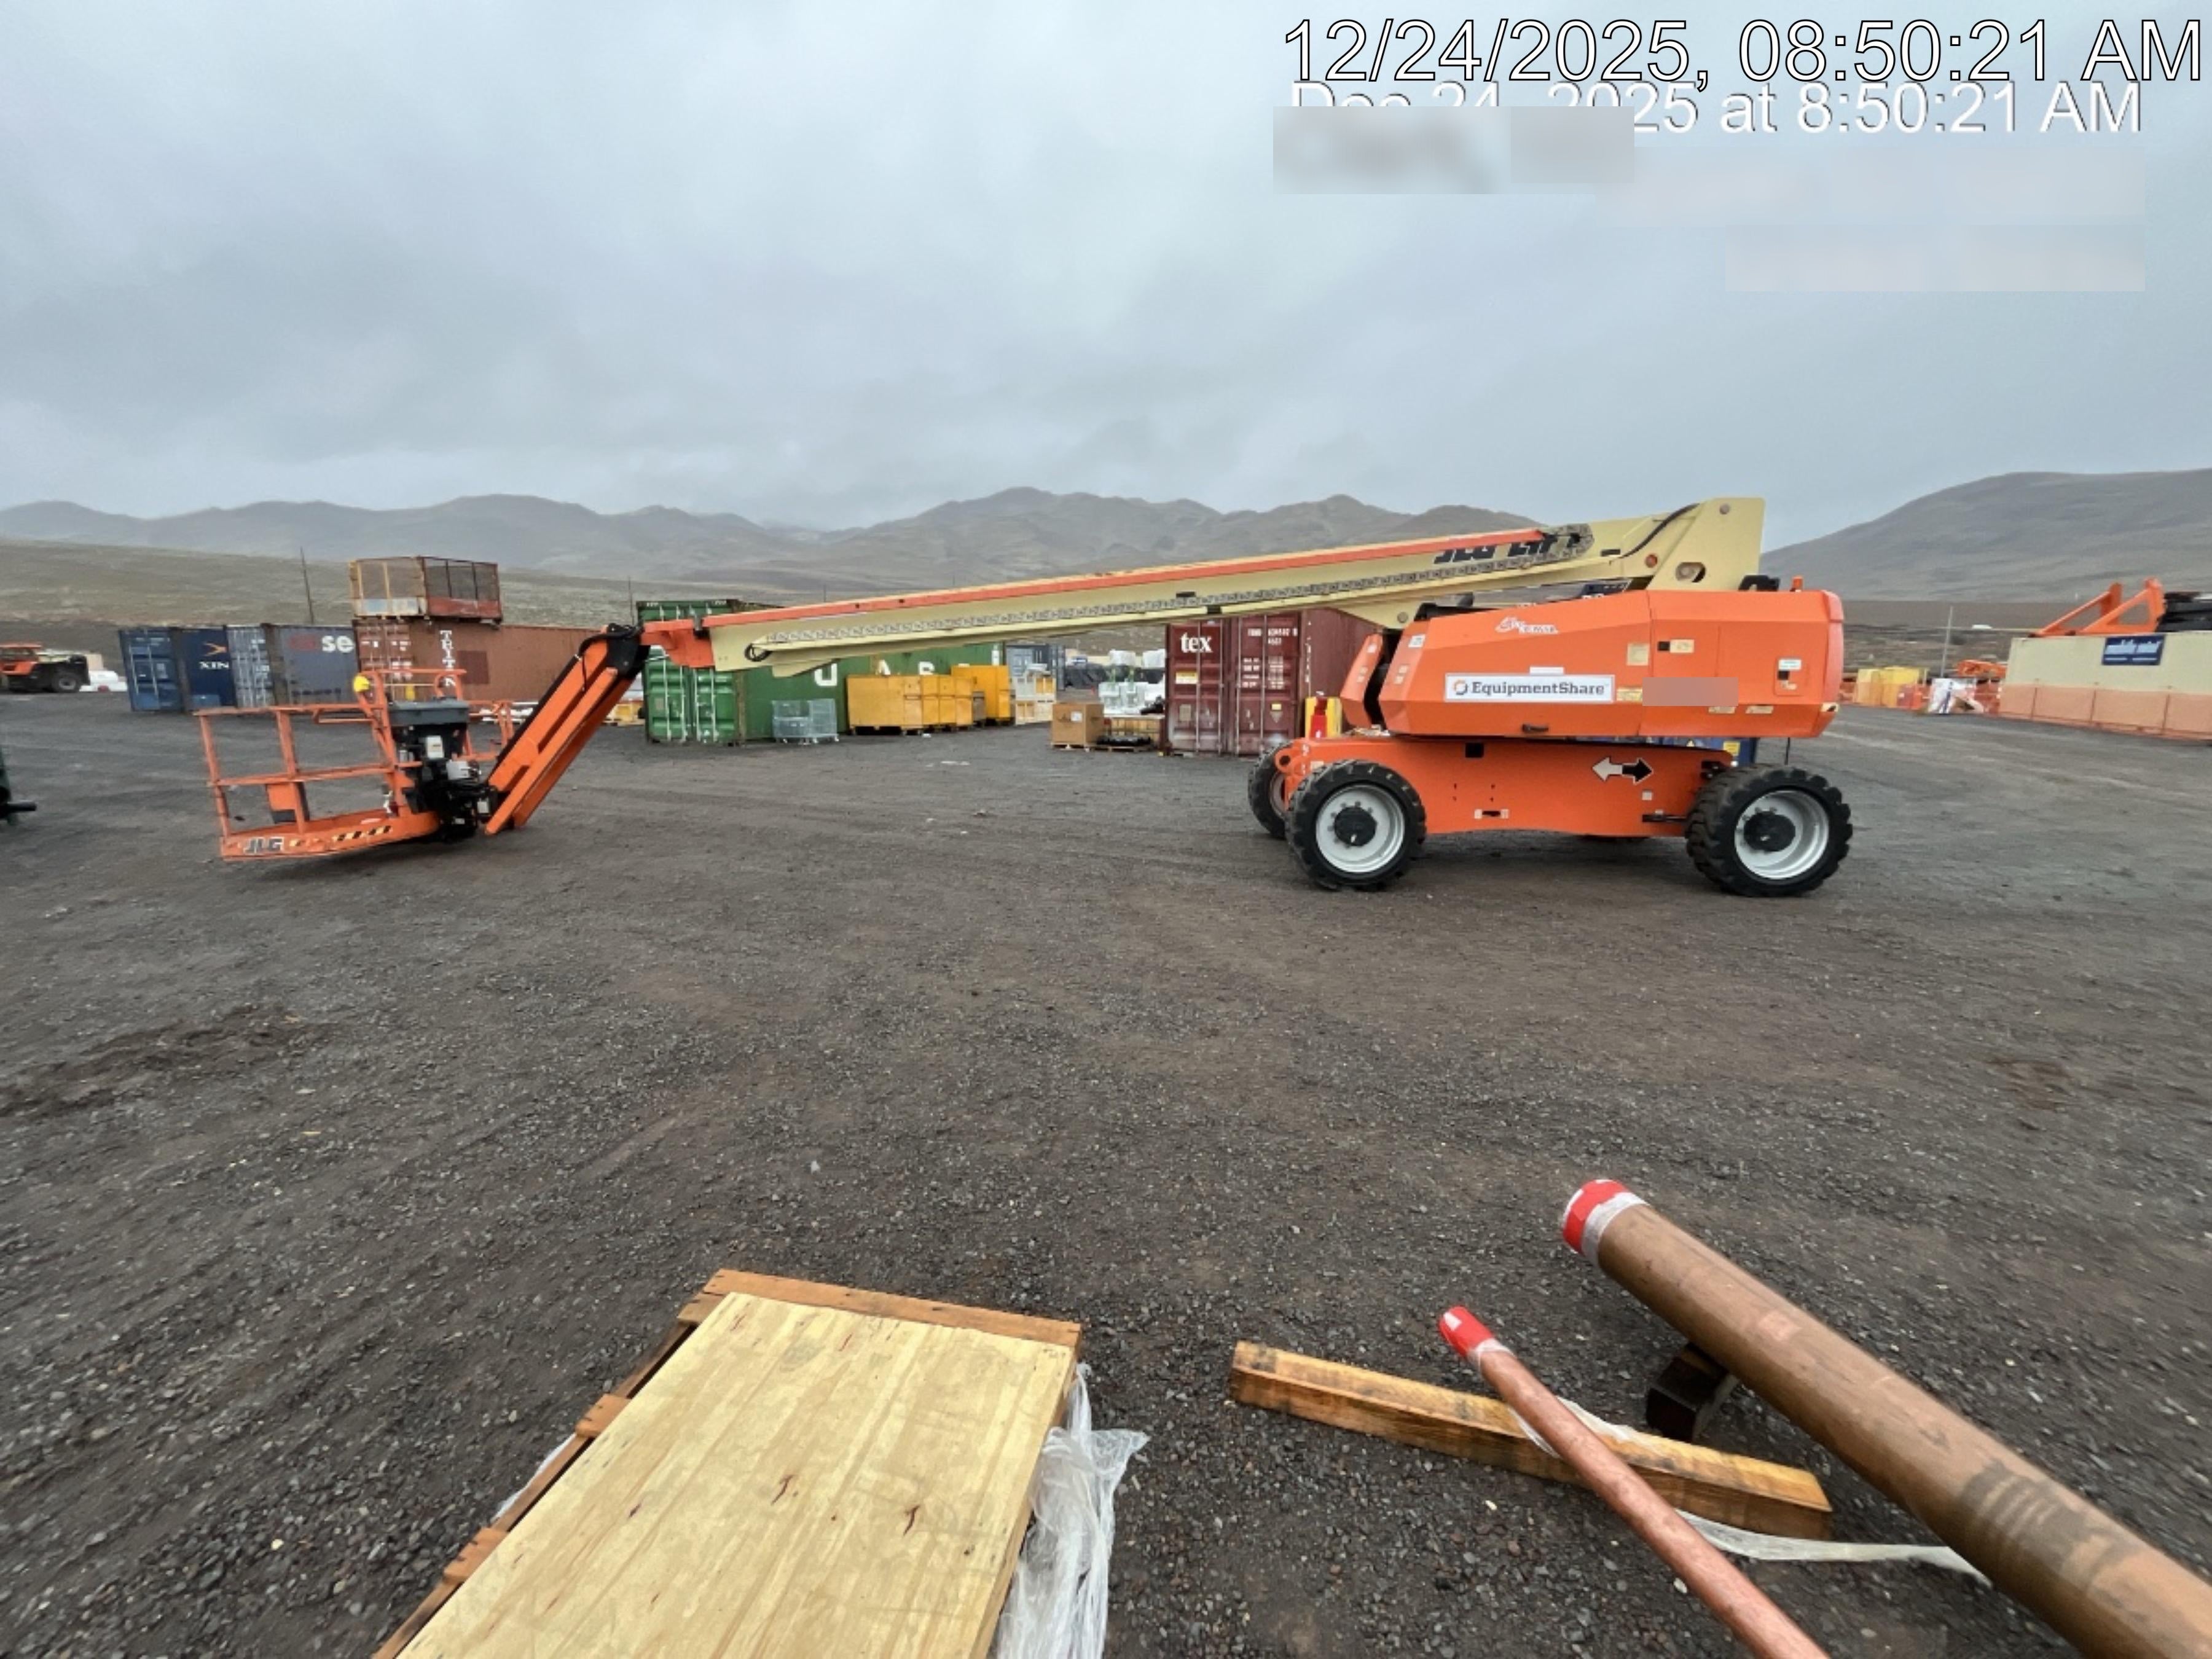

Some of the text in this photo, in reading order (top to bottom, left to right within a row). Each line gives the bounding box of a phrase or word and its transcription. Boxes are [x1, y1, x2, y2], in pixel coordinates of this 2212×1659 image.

[1180, 632, 1214, 653] tex
[440, 630, 456, 686] TRITN
[1472, 681, 1605, 696] EquipmentShare
[243, 837, 285, 855] JLG
